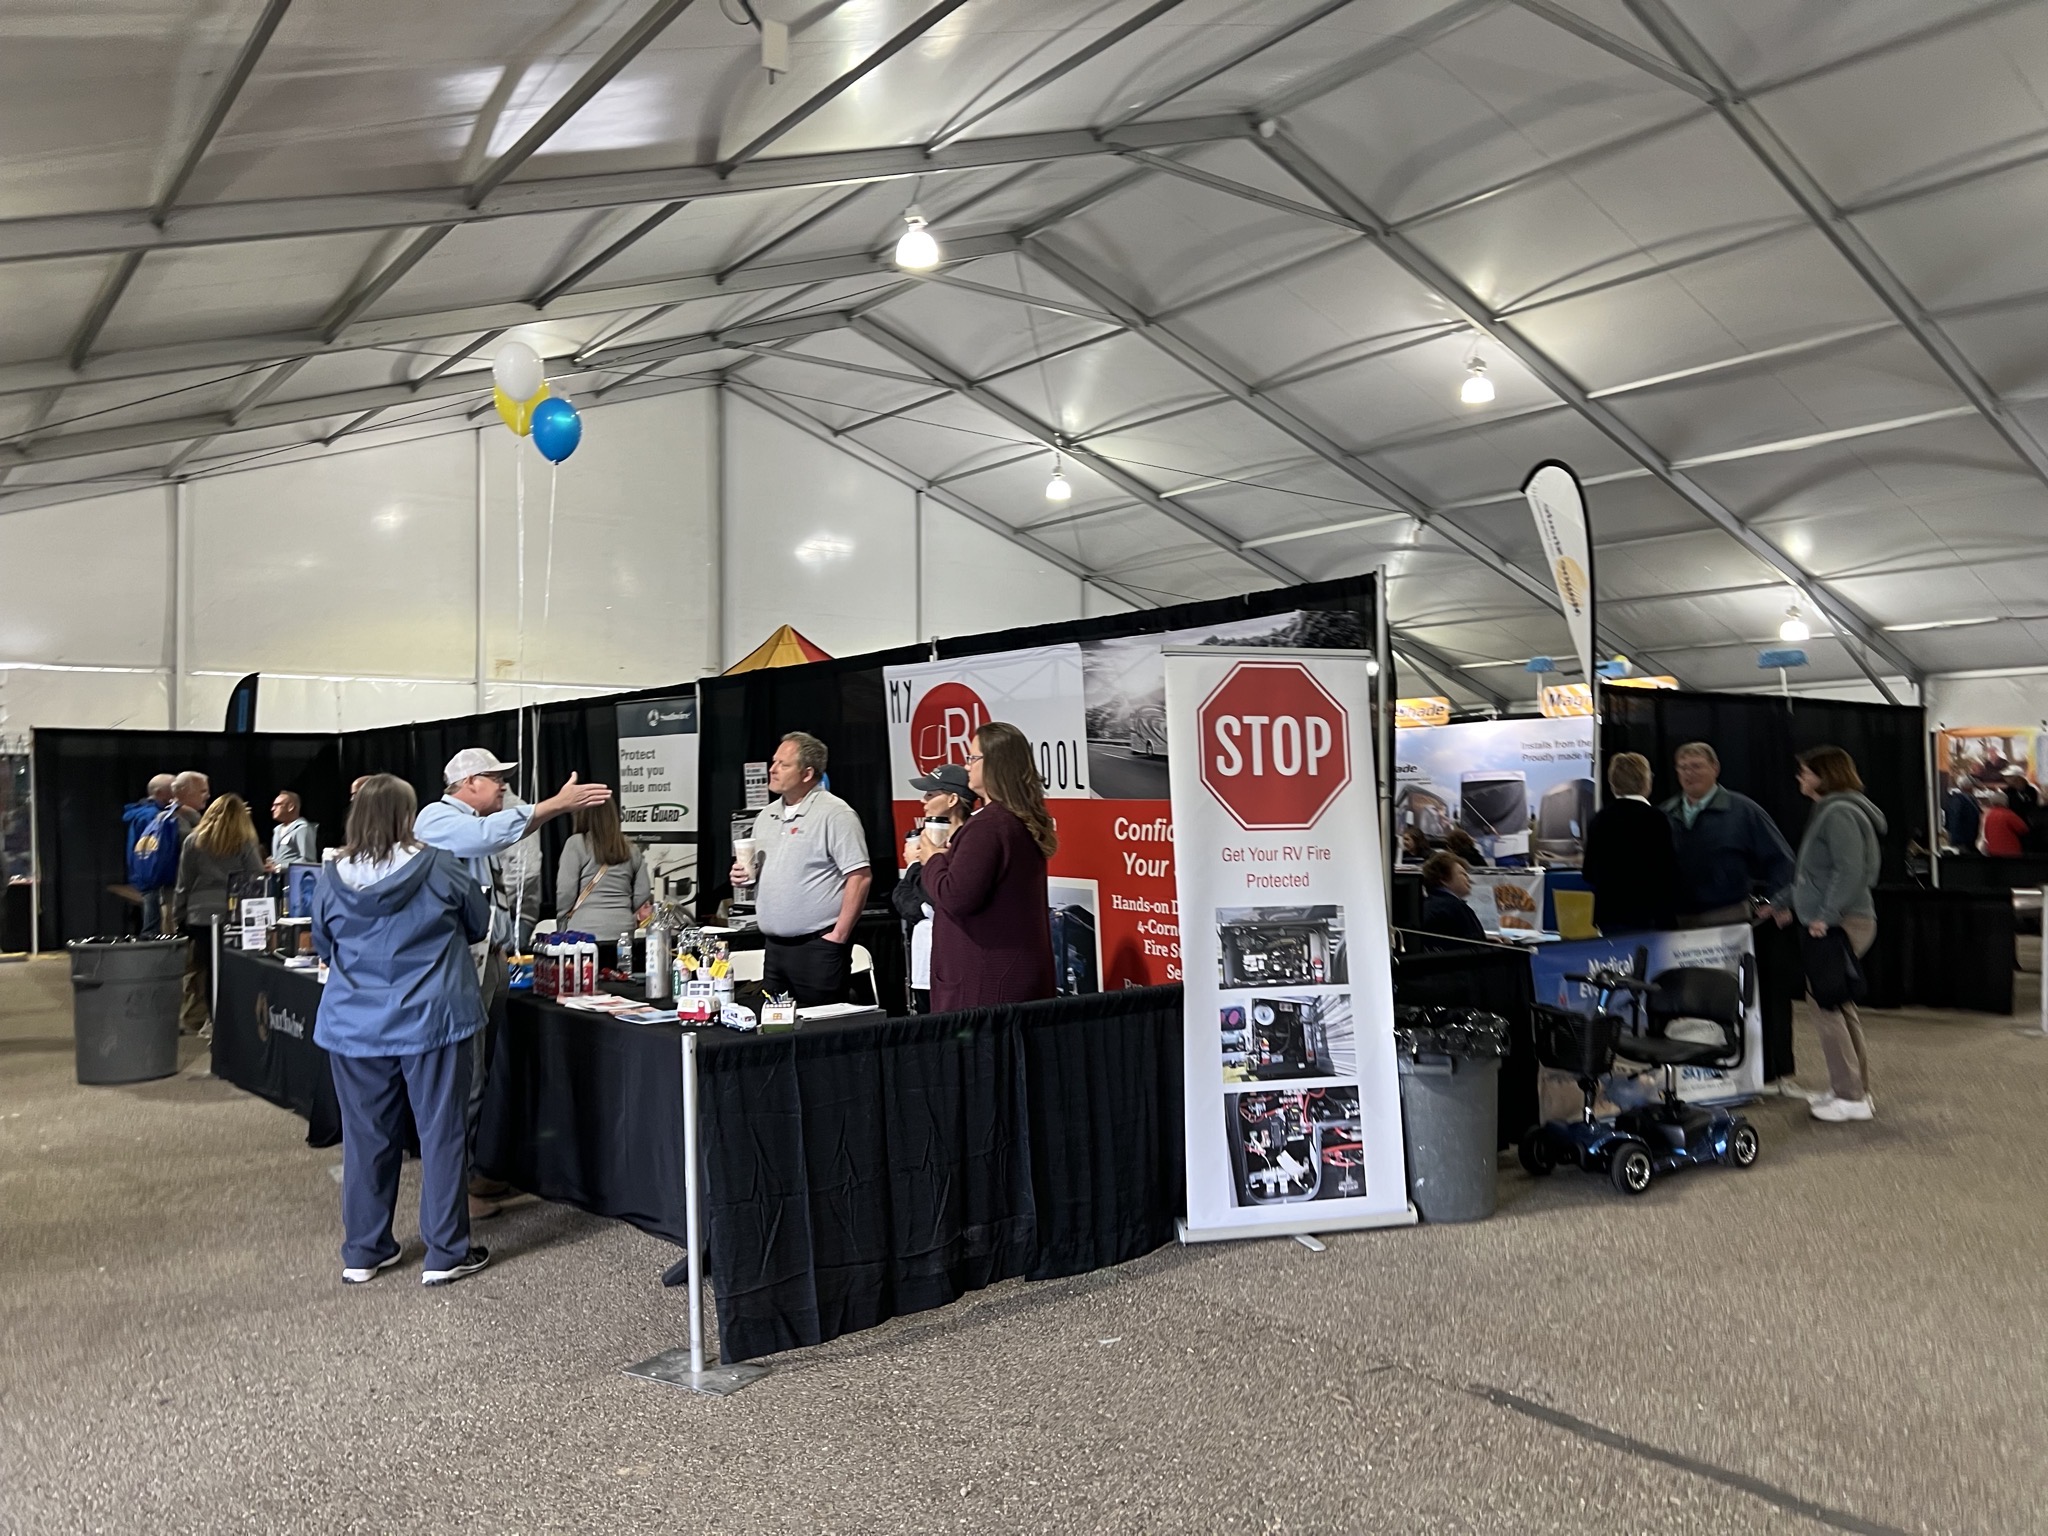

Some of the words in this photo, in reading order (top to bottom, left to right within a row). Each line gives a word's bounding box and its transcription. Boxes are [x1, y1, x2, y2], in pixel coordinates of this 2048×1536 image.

[889, 679, 912, 724] MY
[1214, 714, 1332, 777] STOP
[1521, 740, 1552, 750] Installs
[1555, 739, 1575, 749] from
[620, 749, 656, 761] Protect
[1521, 752, 1554, 763] Proudly
[1557, 751, 1582, 761] made
[646, 766, 665, 779] you
[1394, 763, 1418, 773] ade
[647, 781, 671, 793] most
[620, 805, 648, 823] SURGE
[651, 804, 680, 823] GUARD
[1221, 846, 1245, 862] Get
[1247, 846, 1279, 862] Your
[1282, 845, 1303, 861] RV
[1307, 844, 1331, 861] Fire
[1122, 851, 1170, 878] Your
[1246, 871, 1310, 888] Protected
[1111, 894, 1170, 914] Hands-on
[1136, 918, 1180, 936] 4-Corn
[1143, 938, 1168, 957] Fire
